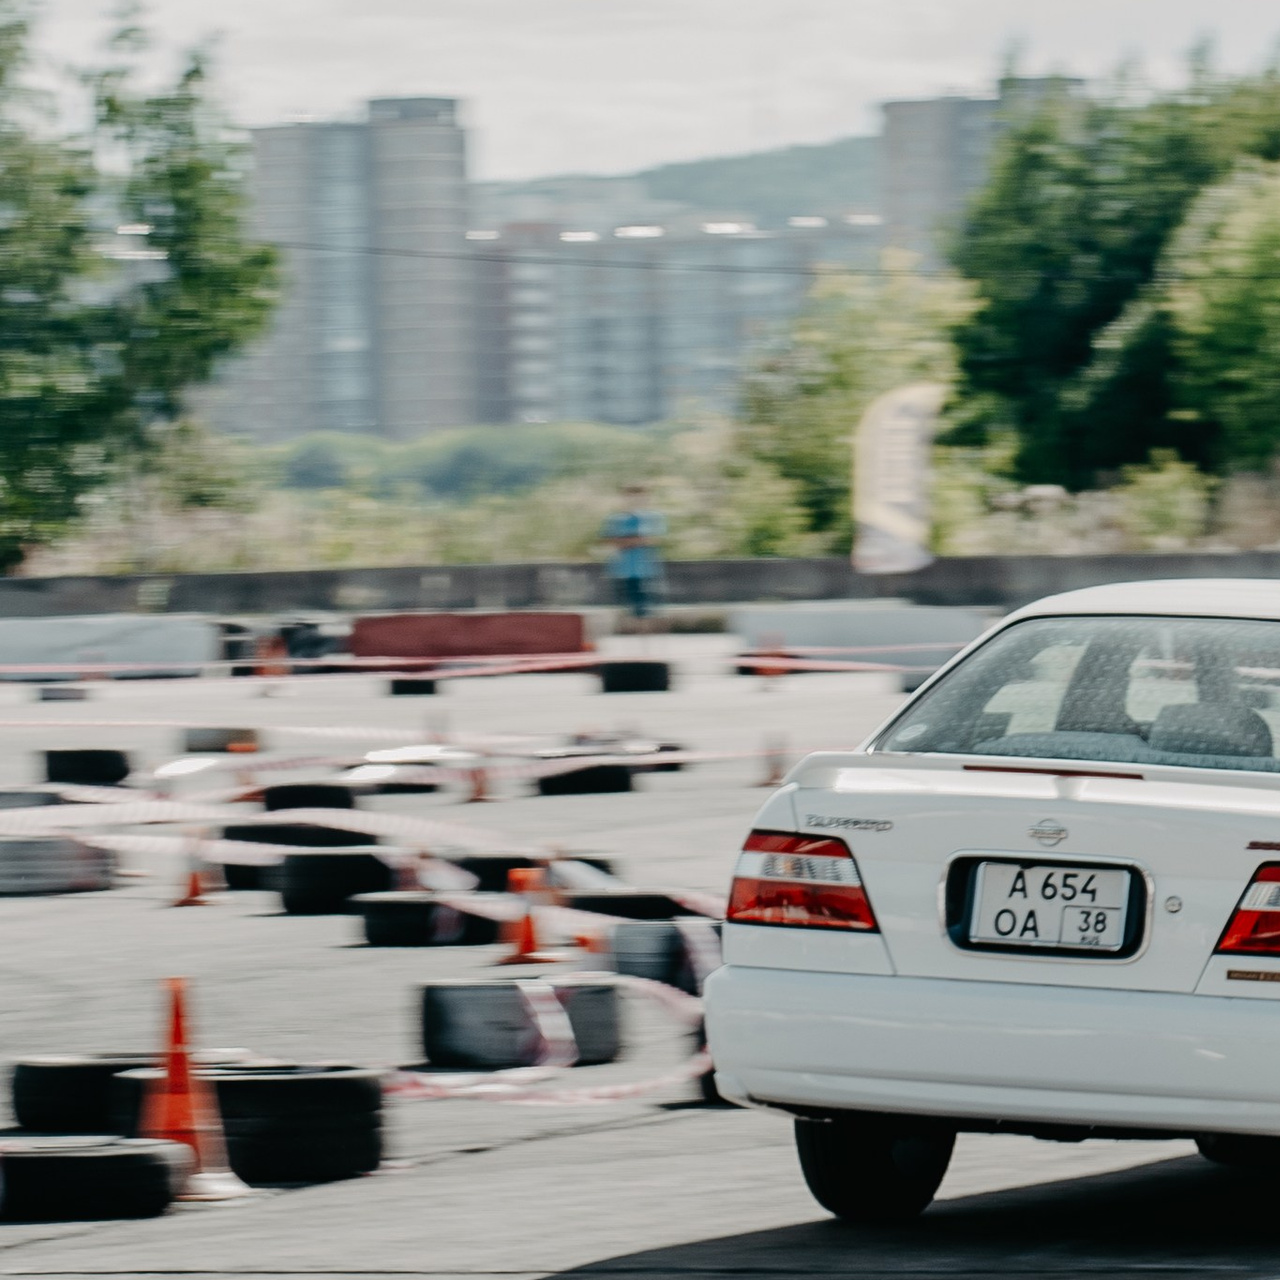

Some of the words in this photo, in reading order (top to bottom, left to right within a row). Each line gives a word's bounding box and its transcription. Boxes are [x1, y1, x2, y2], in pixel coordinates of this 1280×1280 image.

[1008, 870, 1028, 899] A
[1041, 872, 1097, 902] 654
[994, 908, 1039, 938] OA
[1078, 910, 1107, 933] 38
